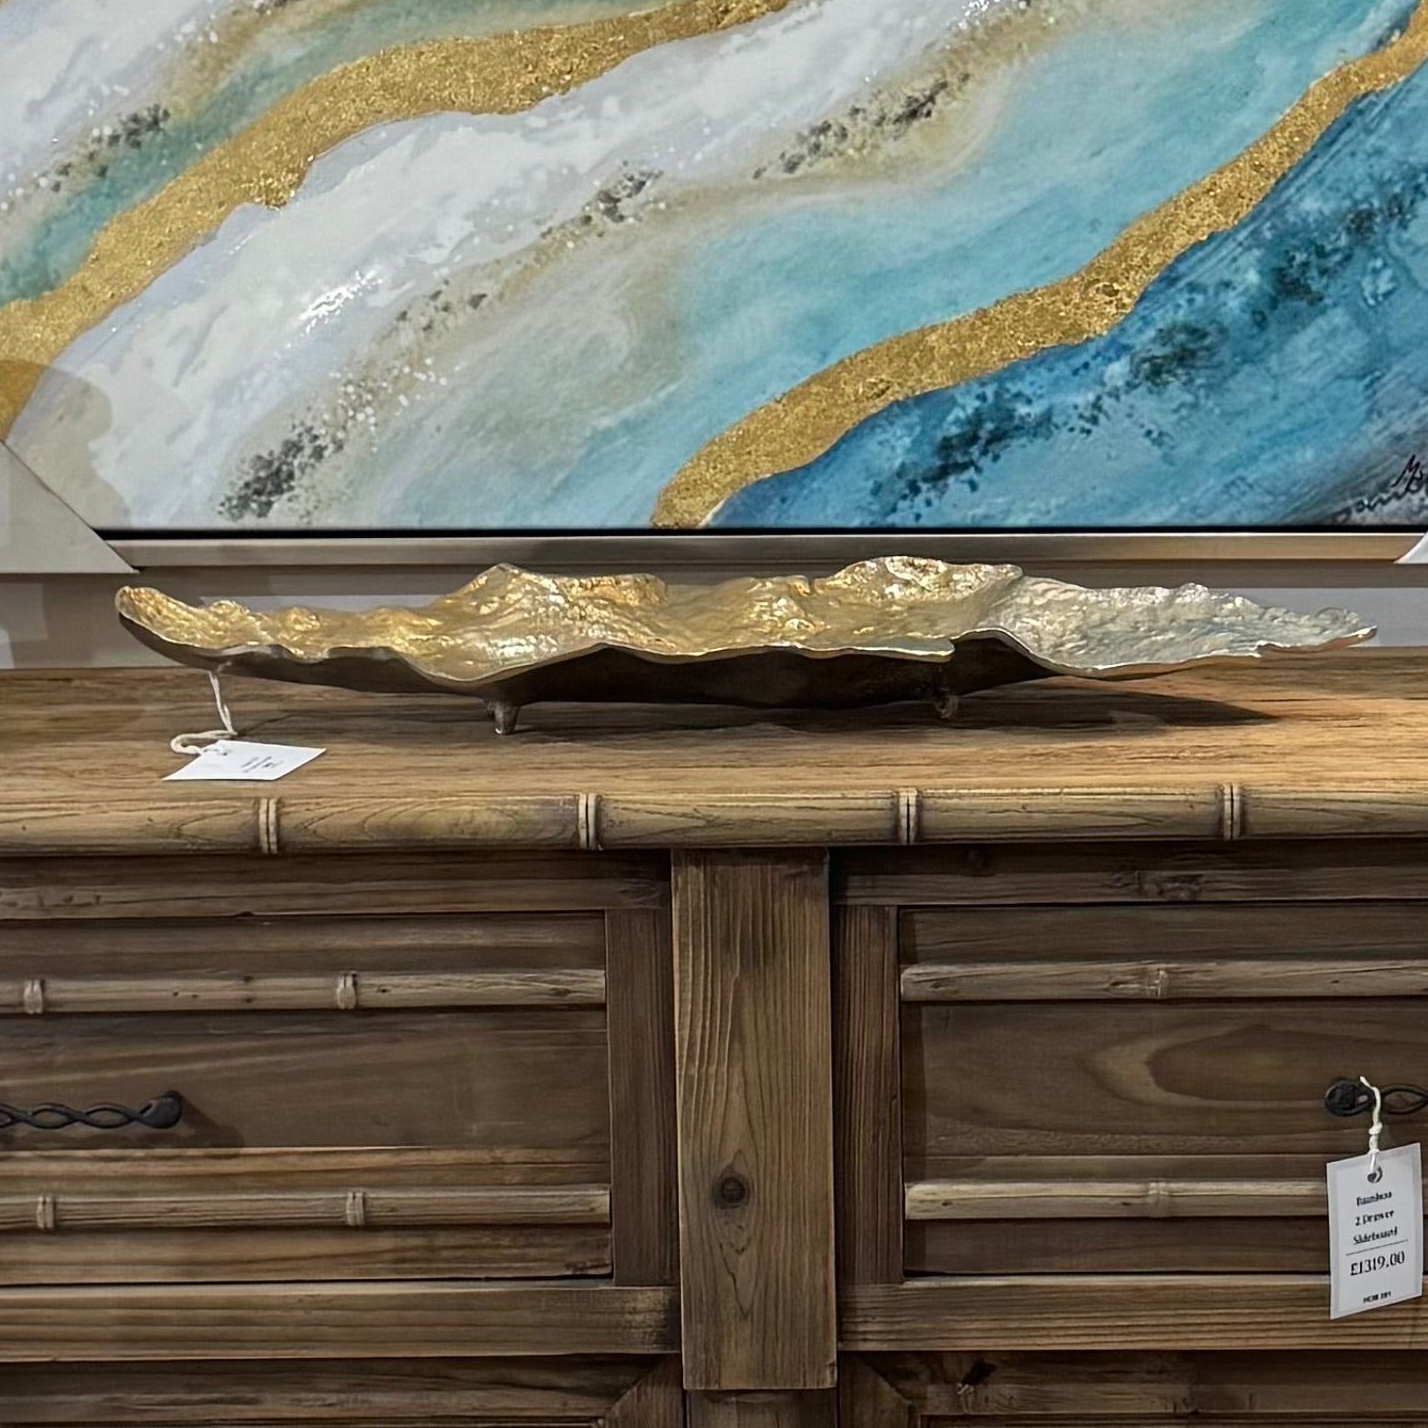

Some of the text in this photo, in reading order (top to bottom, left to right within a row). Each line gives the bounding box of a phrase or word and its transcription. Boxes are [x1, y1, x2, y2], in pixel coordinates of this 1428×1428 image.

[1355, 1209, 1395, 1227] 2 Drawer
[1352, 1225, 1399, 1246] Sideboard
[1349, 1250, 1406, 1276] £1319.00
